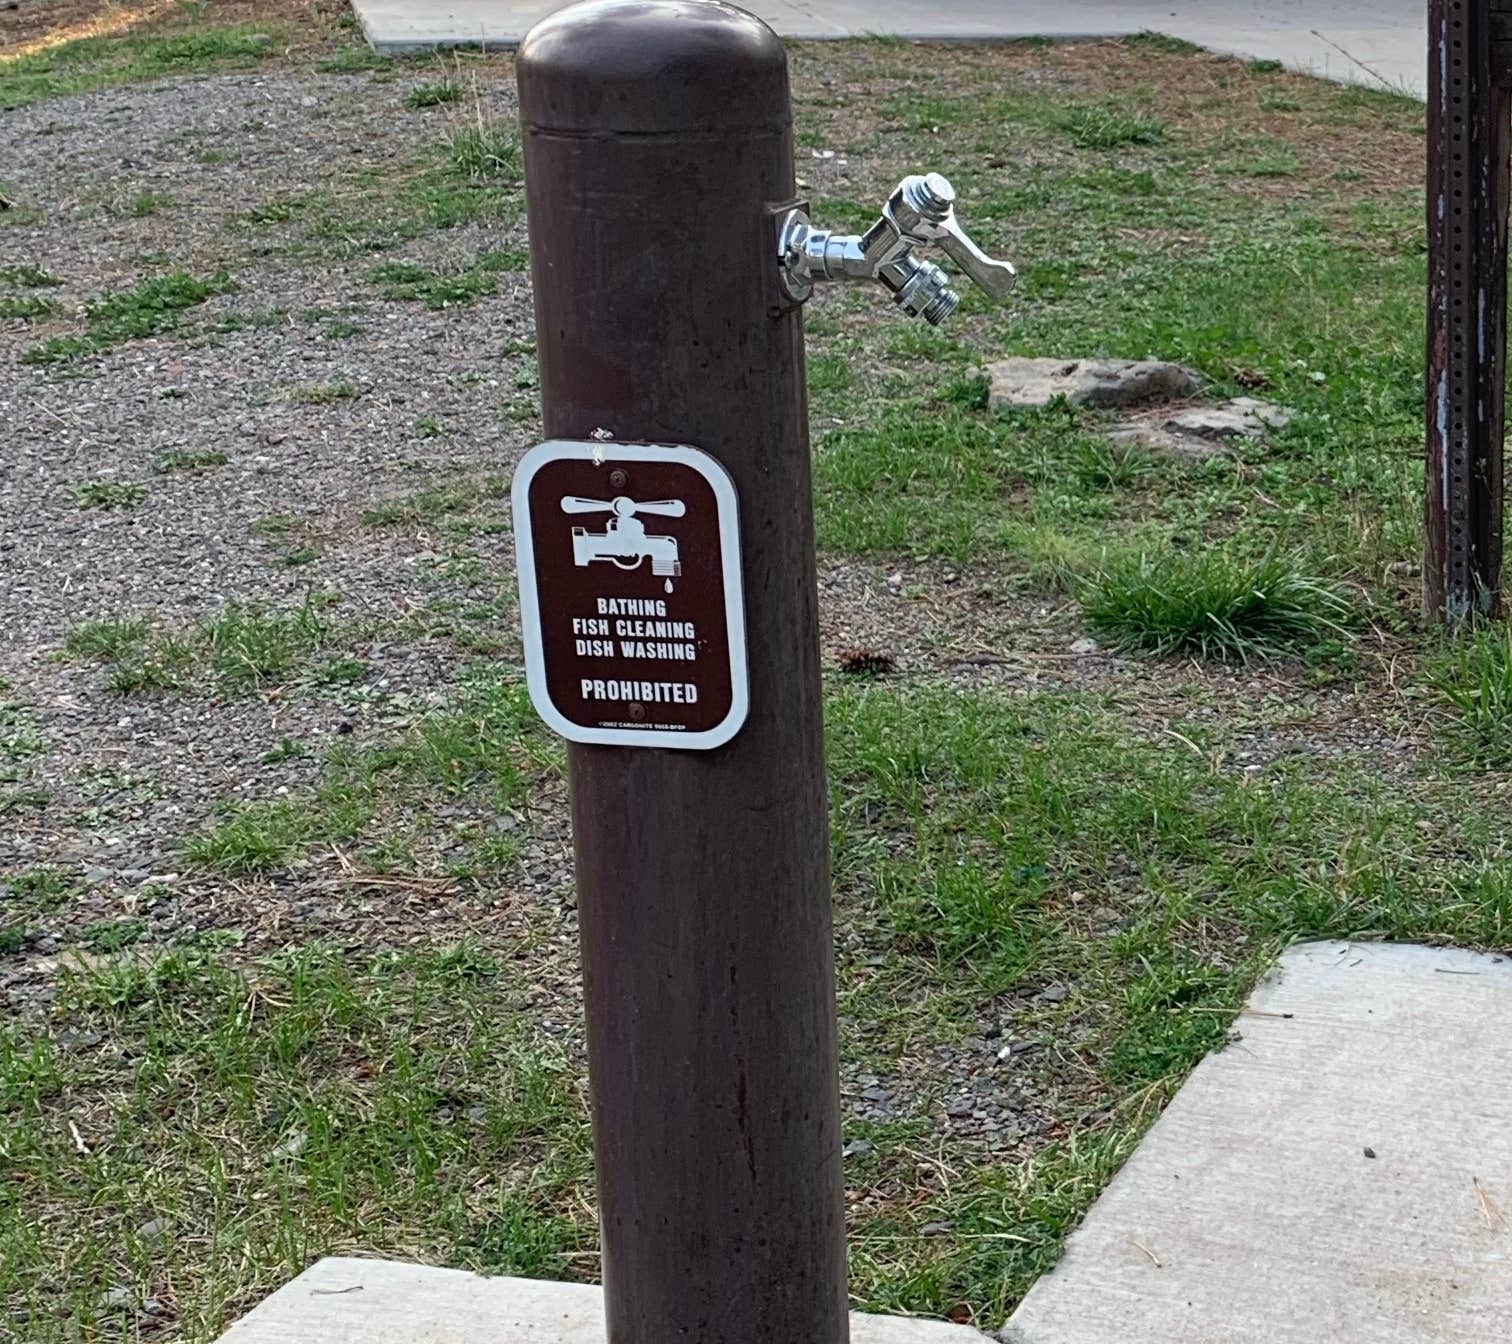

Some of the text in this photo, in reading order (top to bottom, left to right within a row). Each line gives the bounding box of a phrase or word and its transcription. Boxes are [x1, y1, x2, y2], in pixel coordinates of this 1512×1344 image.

[596, 597, 667, 617] BATHING
[572, 618, 696, 640] FISH CLEANING
[575, 640, 697, 661] DISH WASHING
[580, 678, 698, 704] PROHIBITED
